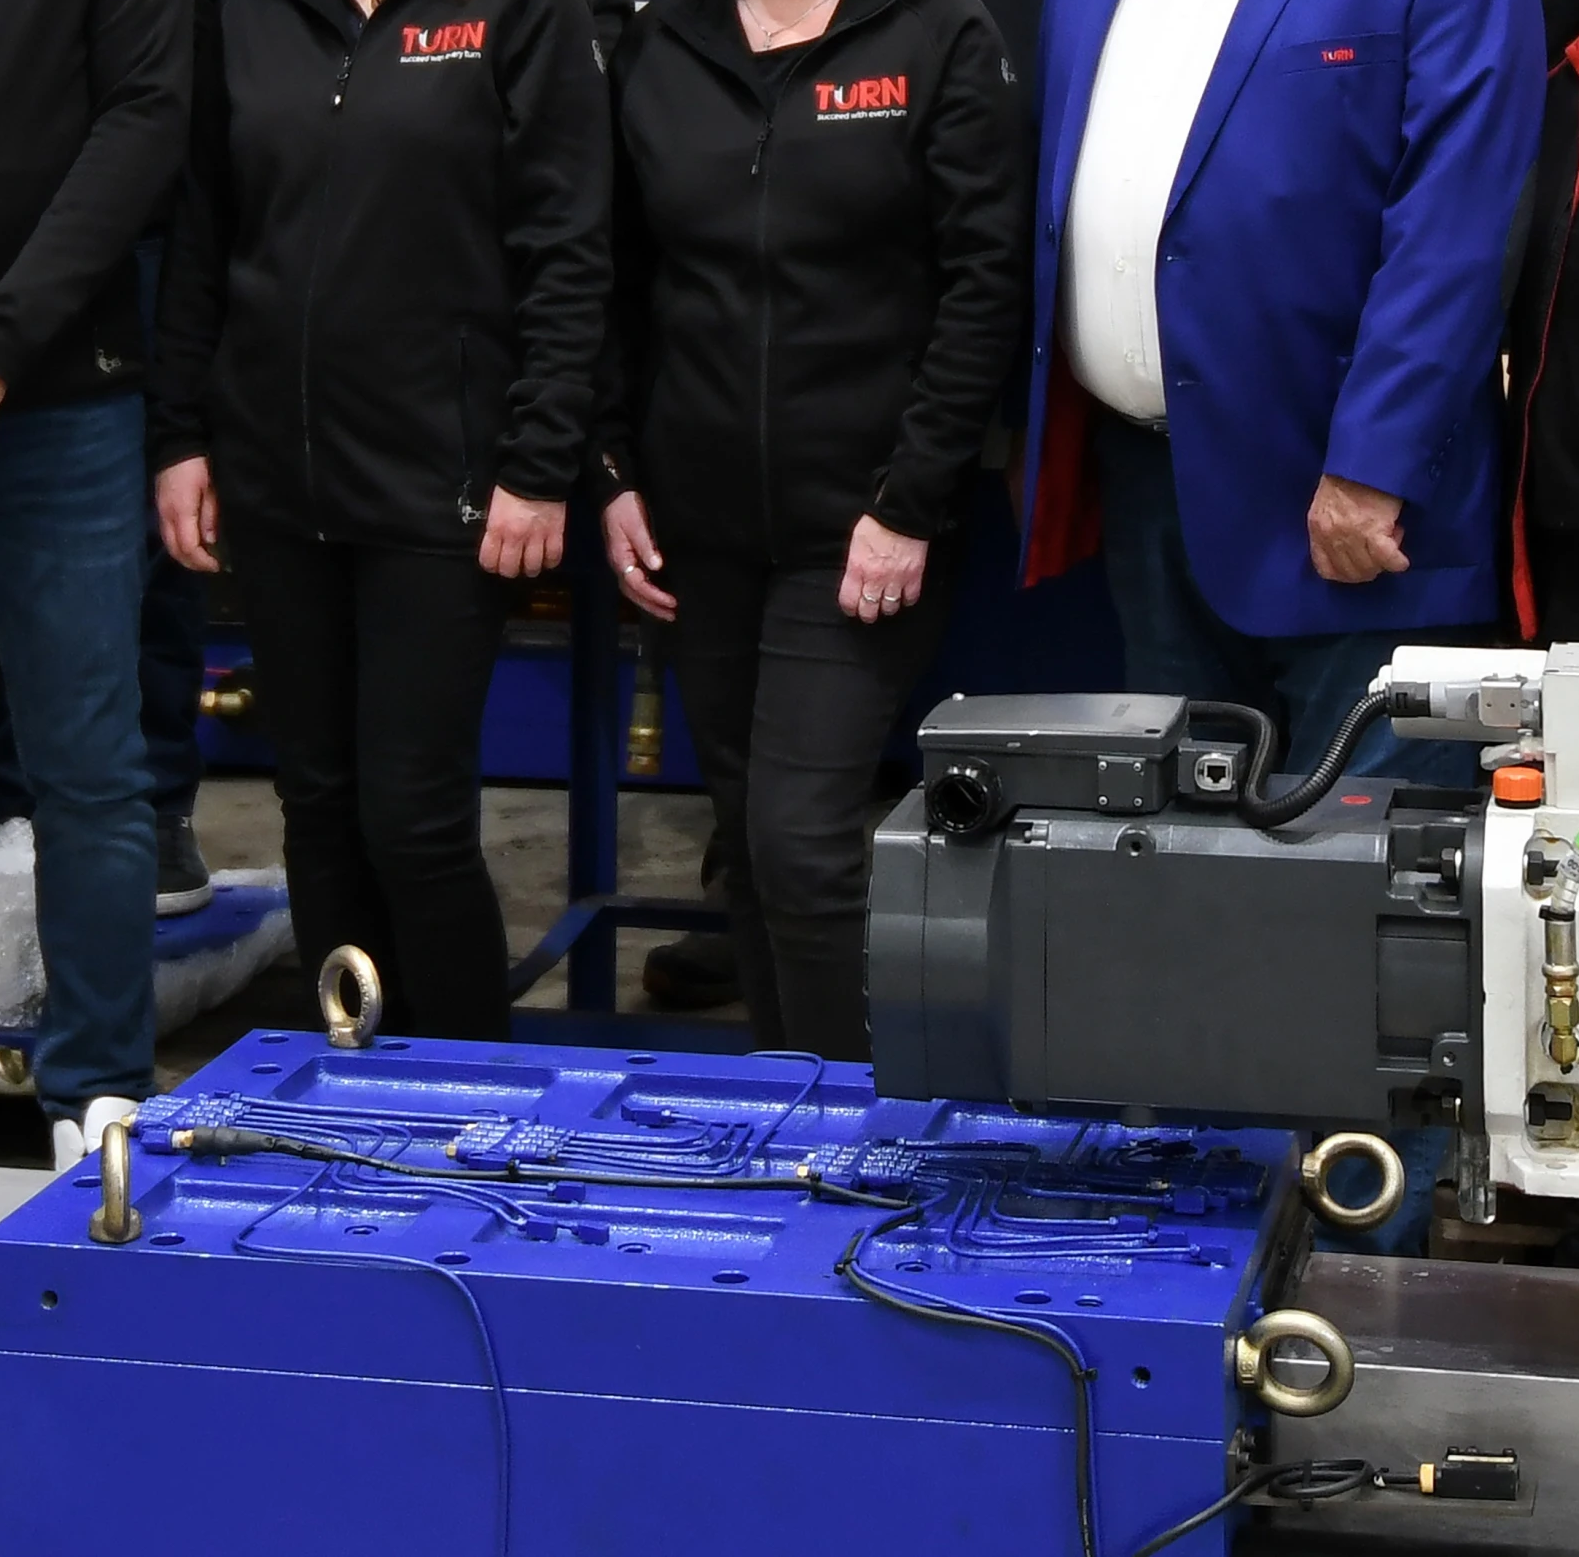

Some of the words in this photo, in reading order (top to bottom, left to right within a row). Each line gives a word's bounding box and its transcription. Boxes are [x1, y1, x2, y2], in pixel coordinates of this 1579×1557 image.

[403, 21, 485, 54] TURN
[1321, 48, 1354, 63] TURN
[815, 75, 906, 111] TURN
[851, 110, 867, 119] with
[868, 110, 890, 119] every
